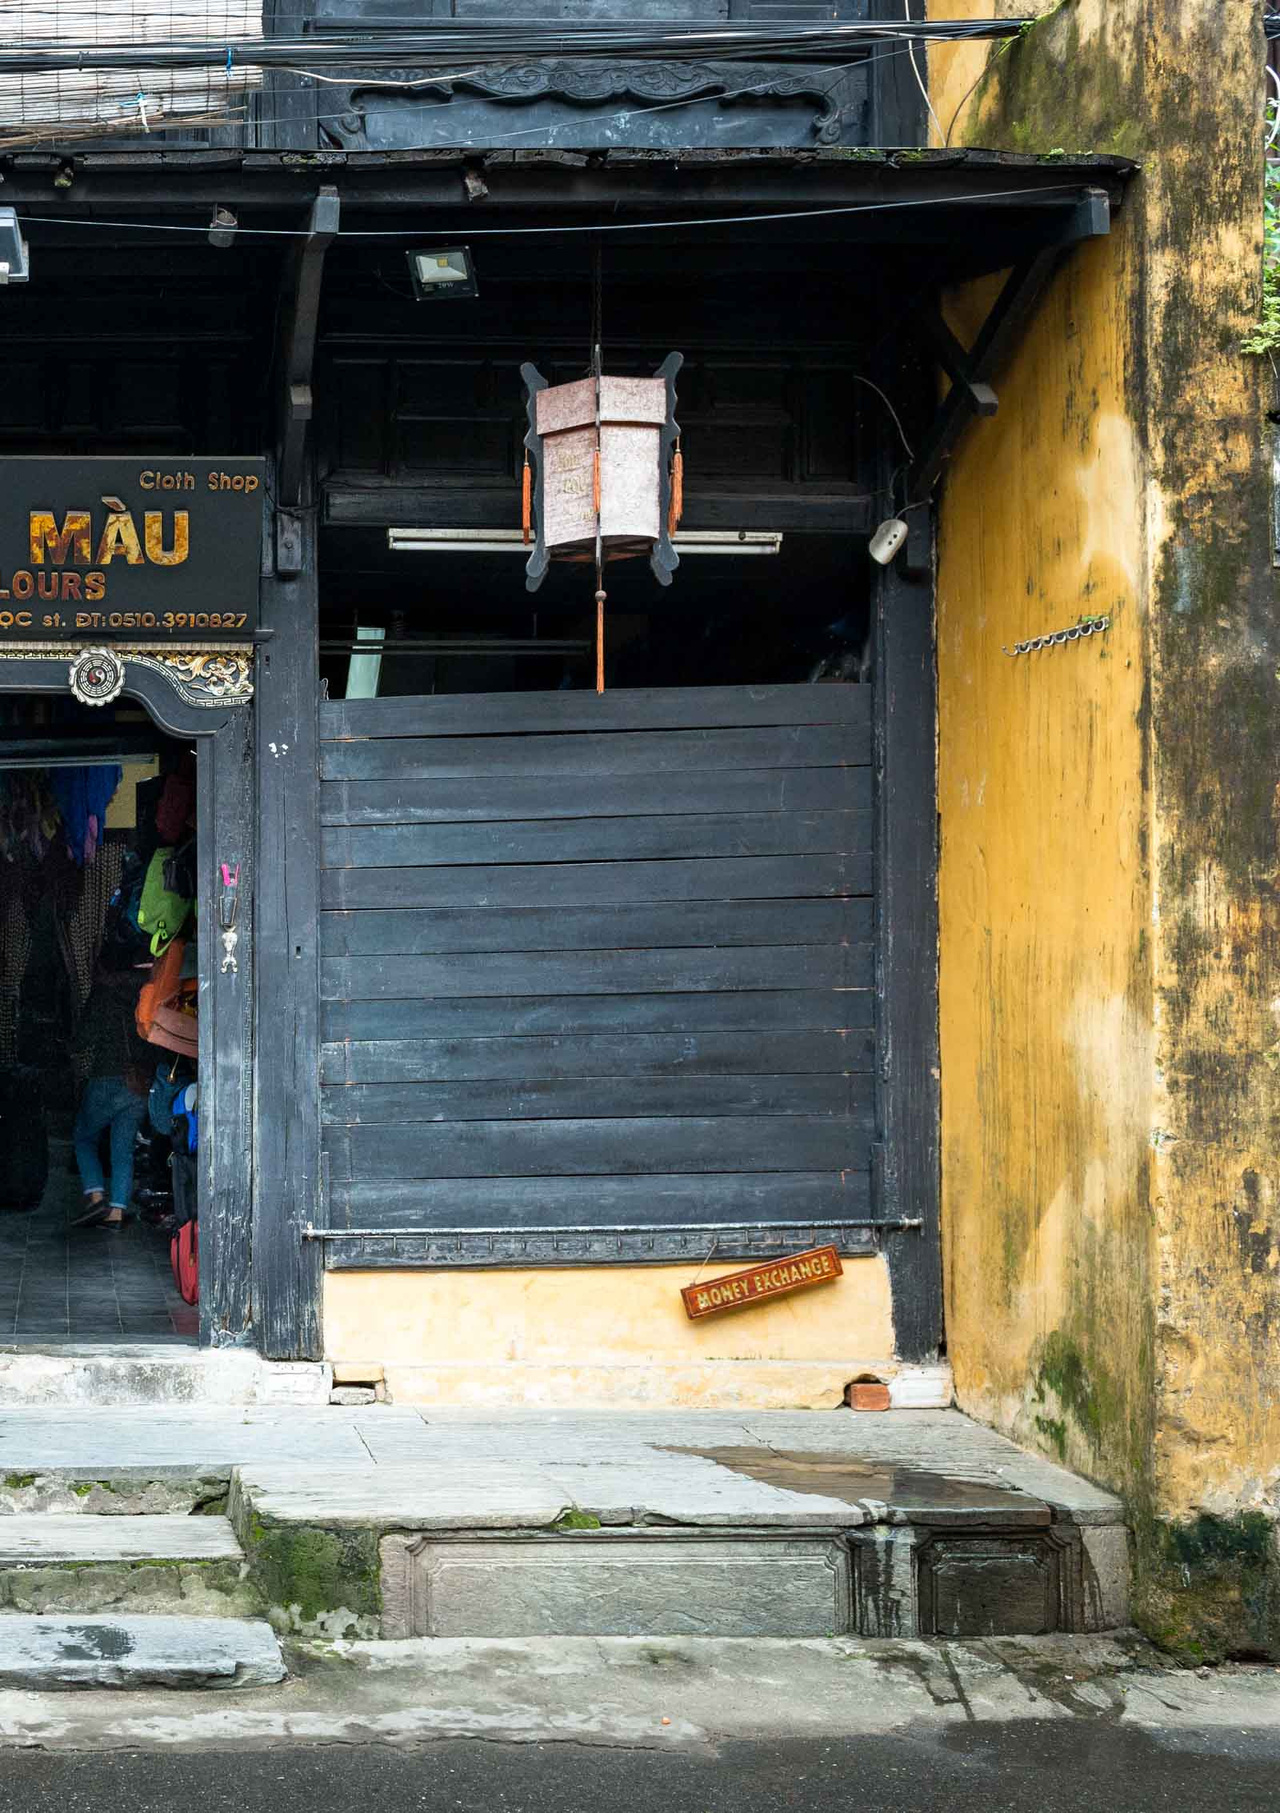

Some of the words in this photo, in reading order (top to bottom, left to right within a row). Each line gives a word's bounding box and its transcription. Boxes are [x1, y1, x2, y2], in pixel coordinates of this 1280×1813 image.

[139, 470, 195, 490] Cloth
[207, 471, 259, 494] Shop
[29, 495, 189, 566] MÀU
[41, 612, 67, 628] st.
[696, 1279, 750, 1310] MONEY
[754, 1255, 831, 1293] EXCHANGE
